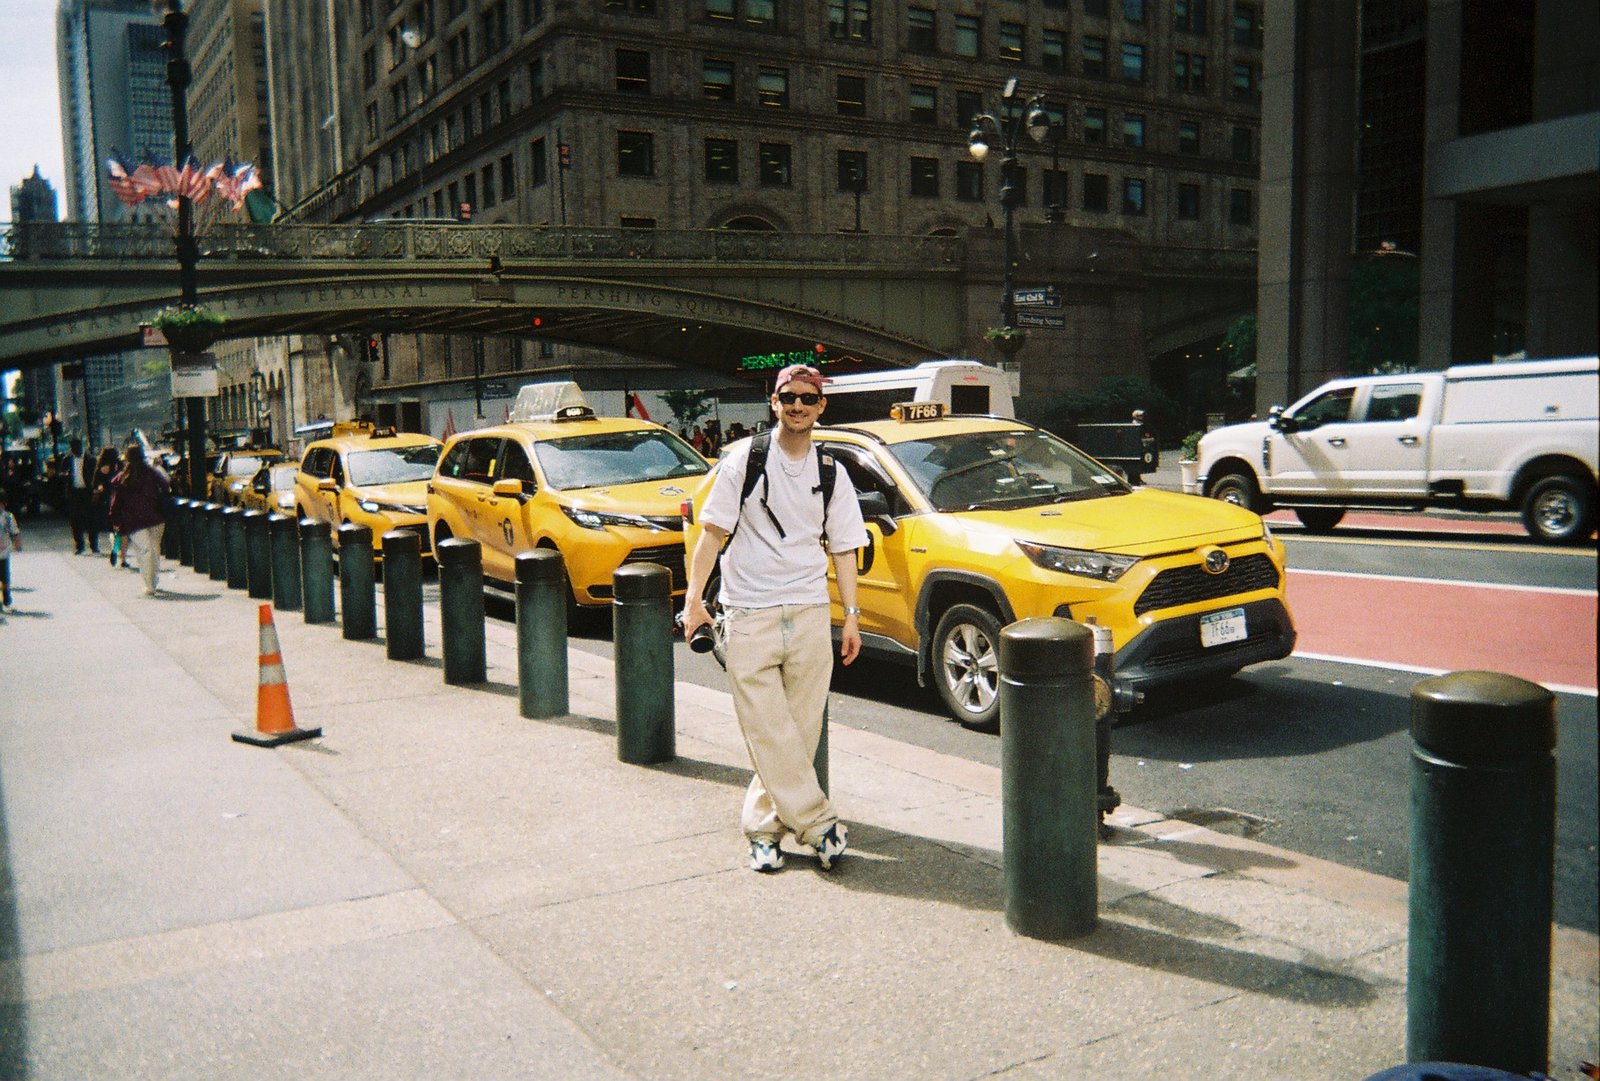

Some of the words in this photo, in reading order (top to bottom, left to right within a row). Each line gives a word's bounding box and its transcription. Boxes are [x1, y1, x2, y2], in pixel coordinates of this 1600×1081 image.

[301, 286, 428, 304] TERMINAL
[558, 286, 661, 307] PERSHING
[675, 300, 749, 320] SQUARE
[741, 352, 785, 370] PERSHING
[910, 405, 937, 419] 7F66
